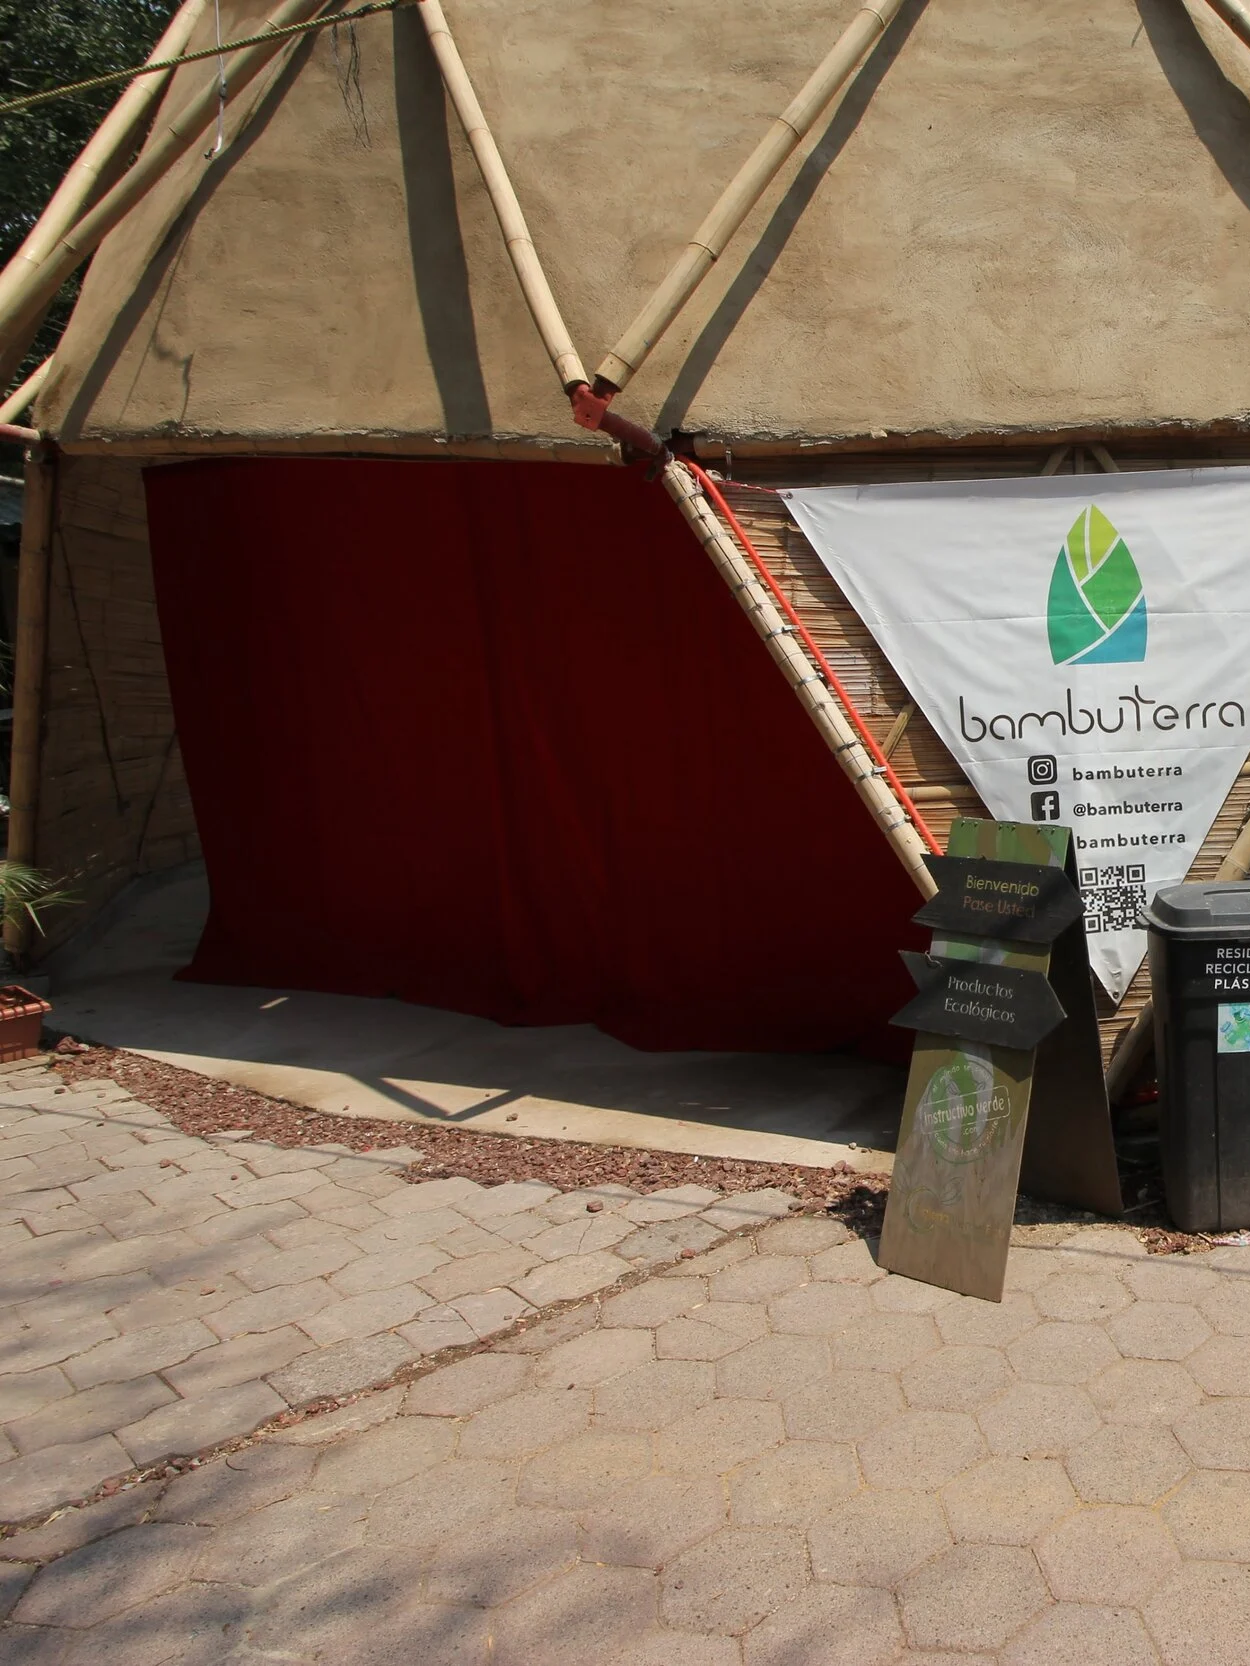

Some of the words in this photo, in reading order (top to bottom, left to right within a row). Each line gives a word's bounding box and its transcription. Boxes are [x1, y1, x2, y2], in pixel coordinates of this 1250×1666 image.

[959, 684, 1246, 743] bambuterra
[1072, 766, 1183, 781] bambuterra
[1073, 802, 1183, 817] @bambuterra
[1076, 833, 1186, 849] bambuterra
[966, 874, 1040, 897] Bienvenido
[963, 896, 993, 913] Pase
[997, 900, 1036, 918] Usted
[948, 976, 1014, 999] Productos
[944, 998, 1016, 1023] Ecológicos
[976, 1096, 1005, 1113] verde
